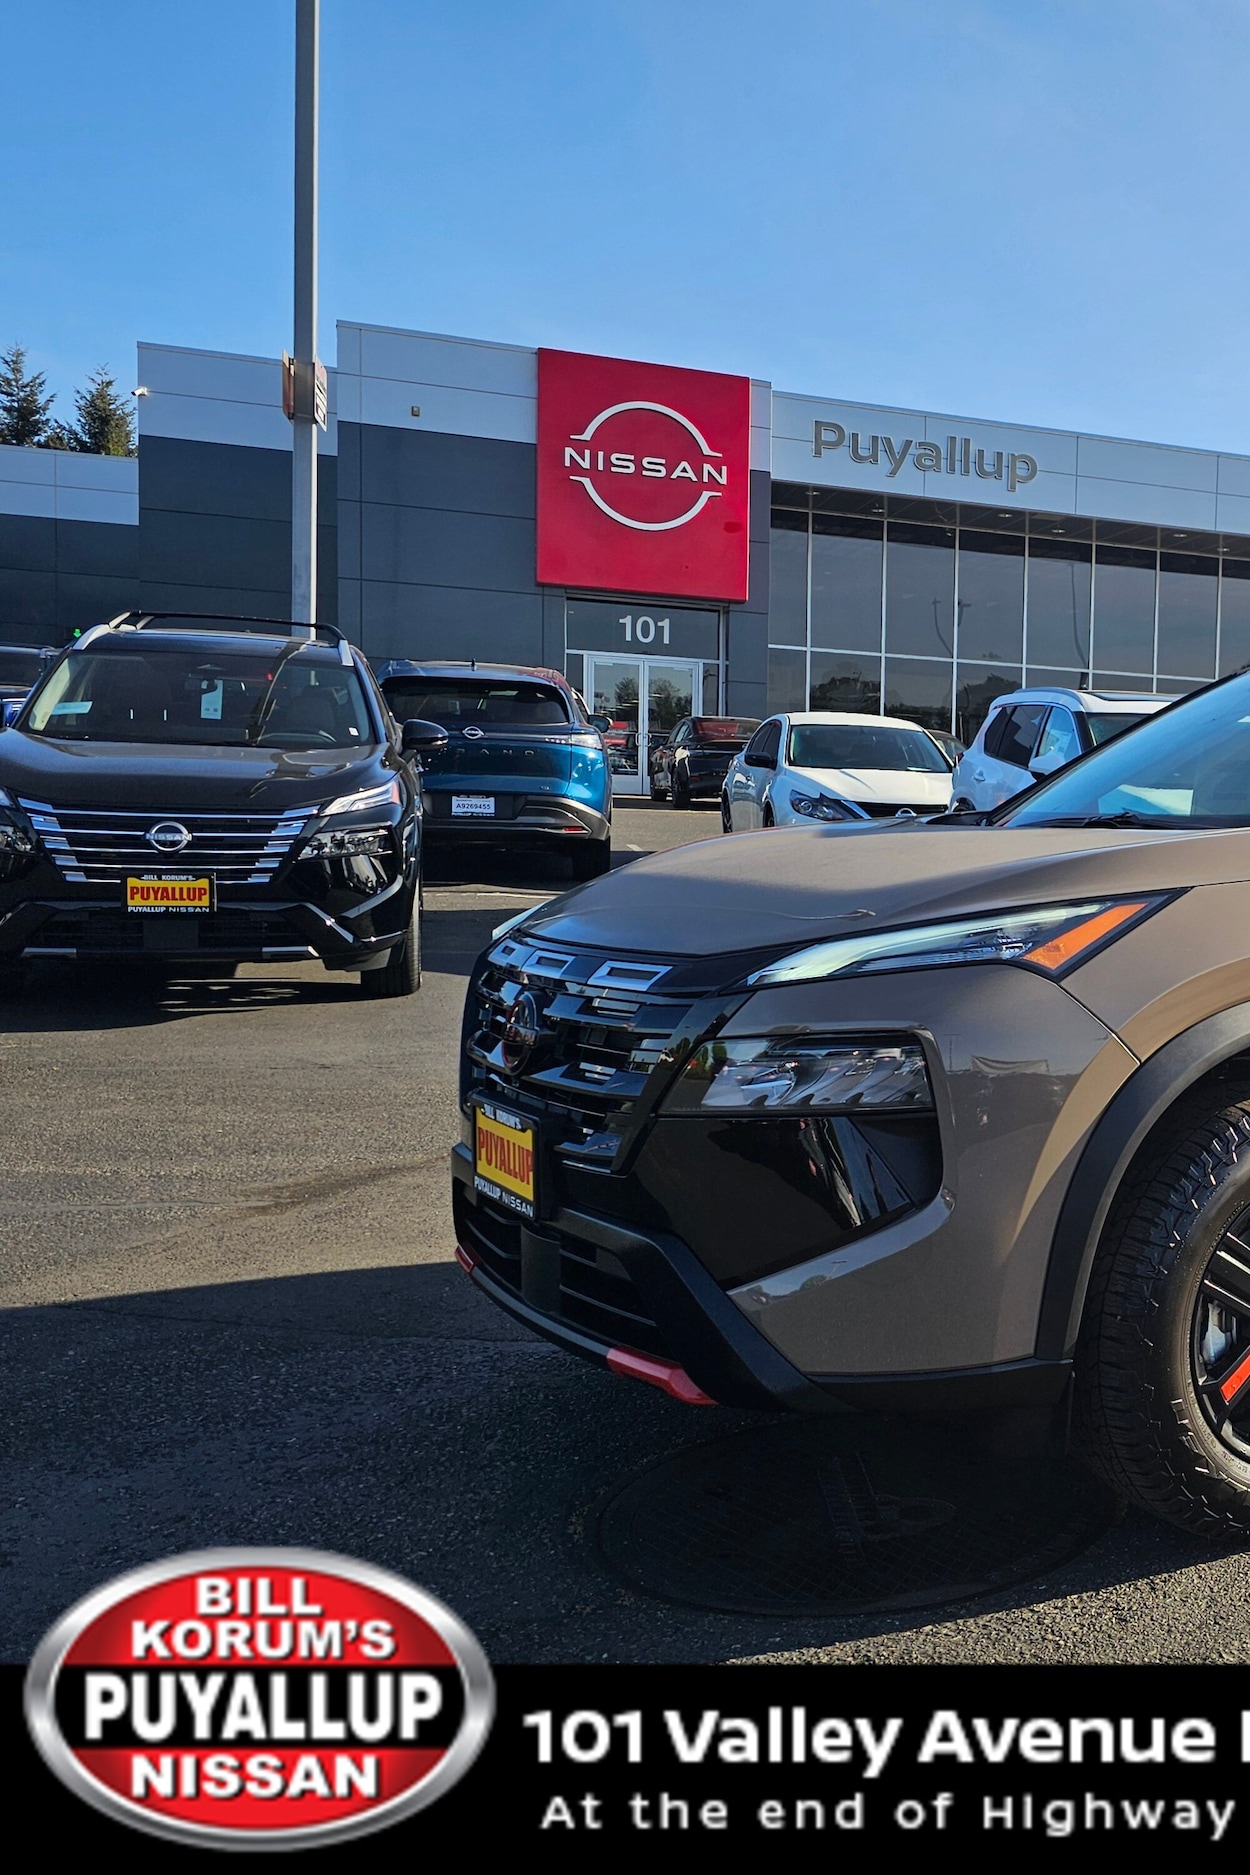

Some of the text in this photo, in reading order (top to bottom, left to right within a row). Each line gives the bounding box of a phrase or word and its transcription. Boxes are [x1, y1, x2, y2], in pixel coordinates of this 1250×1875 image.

[564, 446, 728, 486] NISSAN
[812, 419, 1039, 492] Puyallup
[618, 614, 671, 645] 101
[145, 832, 192, 841] NISSAN
[129, 886, 208, 902] PUYALLUP
[477, 1126, 534, 1186] PUYALLUP
[502, 1191, 534, 1218] NISSAN
